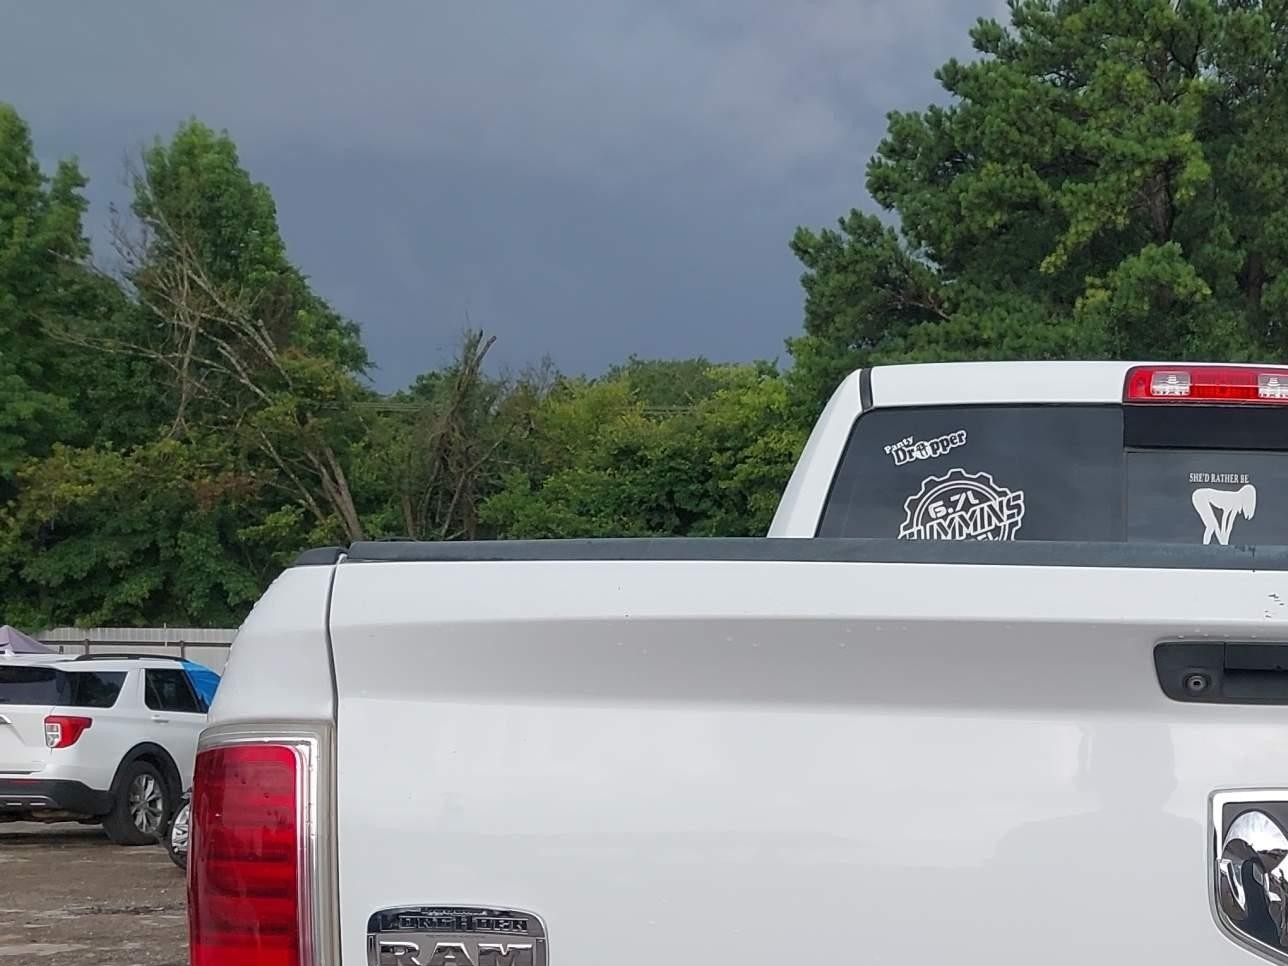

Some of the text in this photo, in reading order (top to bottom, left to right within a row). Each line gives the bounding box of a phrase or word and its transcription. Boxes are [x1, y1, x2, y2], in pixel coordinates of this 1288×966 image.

[1189, 472, 1250, 484] SHE'D RATHER BE
[928, 490, 979, 519] 6.7L
